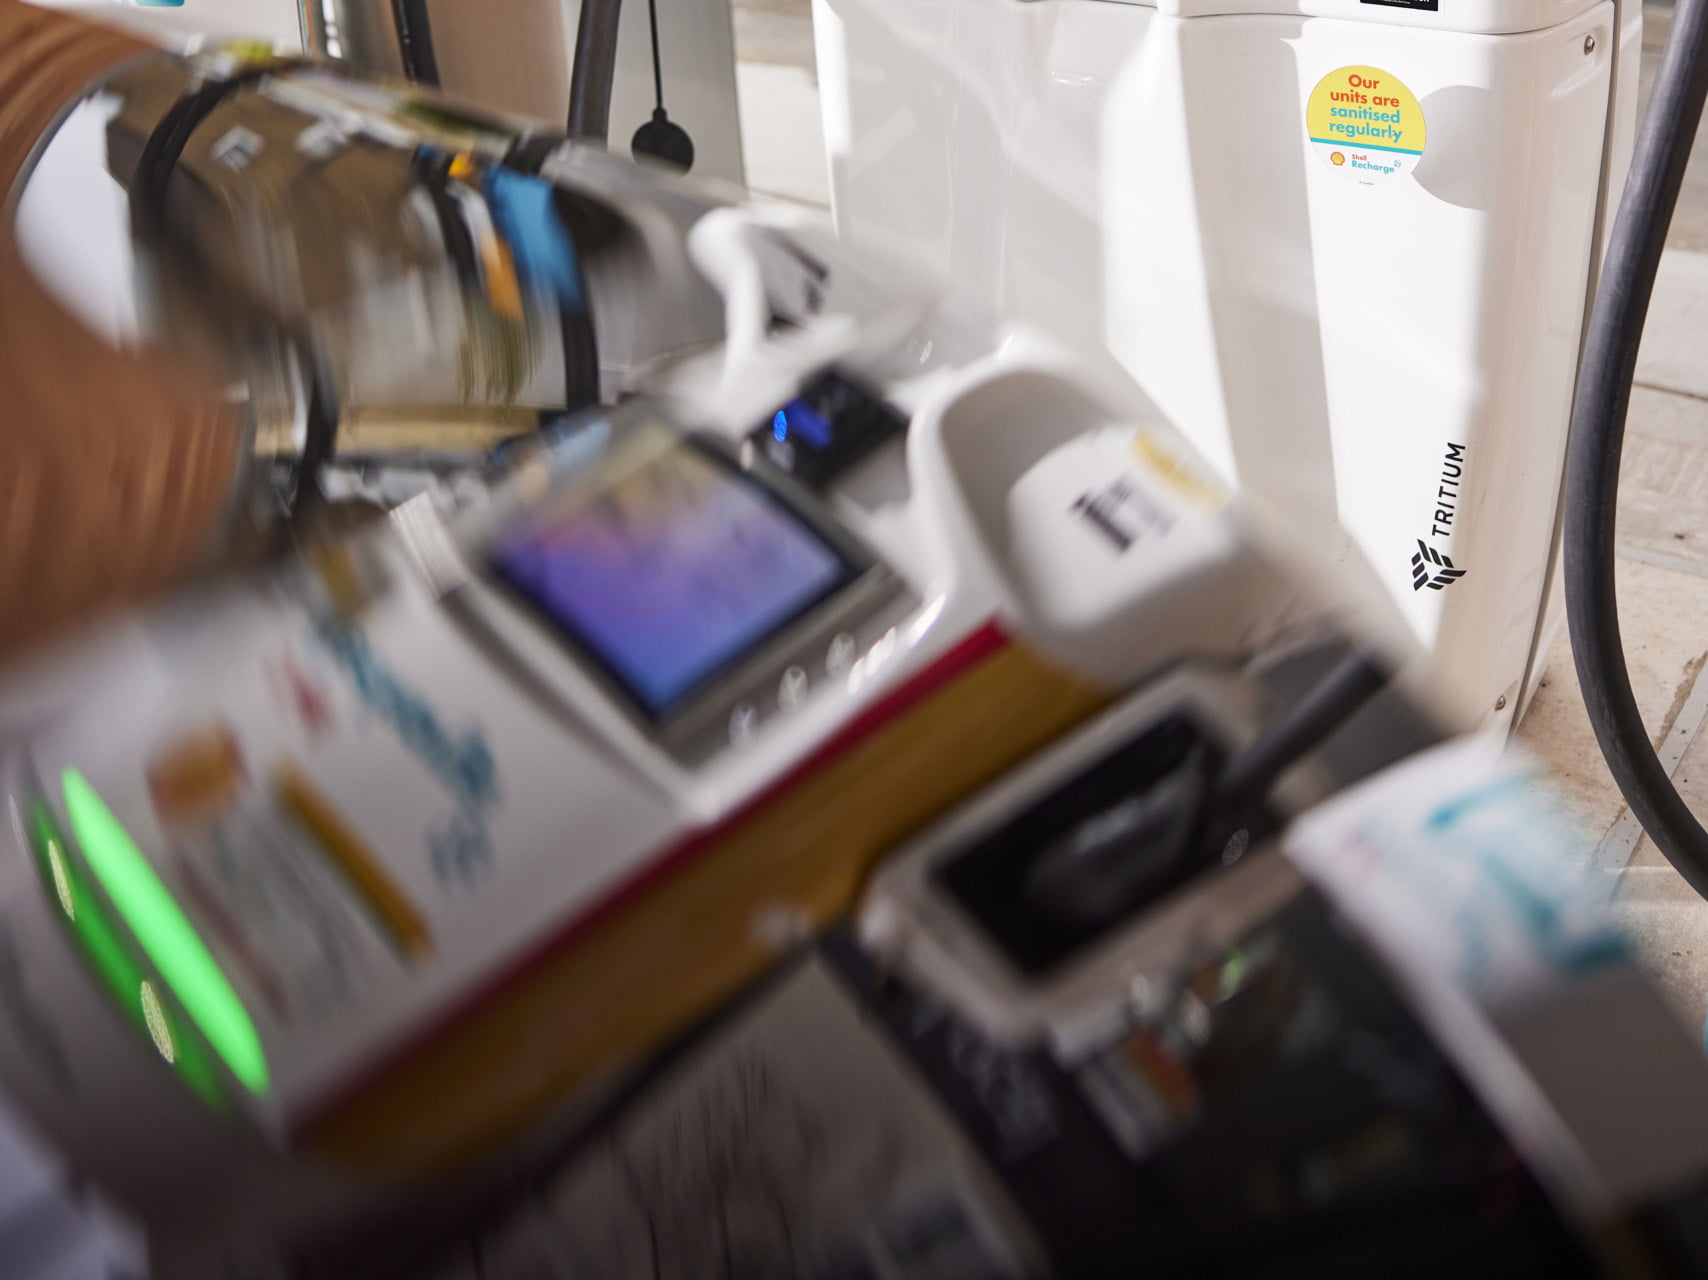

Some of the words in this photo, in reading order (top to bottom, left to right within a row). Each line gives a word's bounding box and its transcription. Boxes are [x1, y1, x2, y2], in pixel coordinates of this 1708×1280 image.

[1348, 74, 1380, 89] Our
[1330, 89, 1368, 104] units
[1372, 96, 1400, 107] are
[1330, 106, 1401, 123] sanitised
[1329, 122, 1403, 143] regularly
[1352, 153, 1367, 161] Shell
[1351, 160, 1395, 174] Recharge
[1432, 442, 1466, 536] TRITIUM
